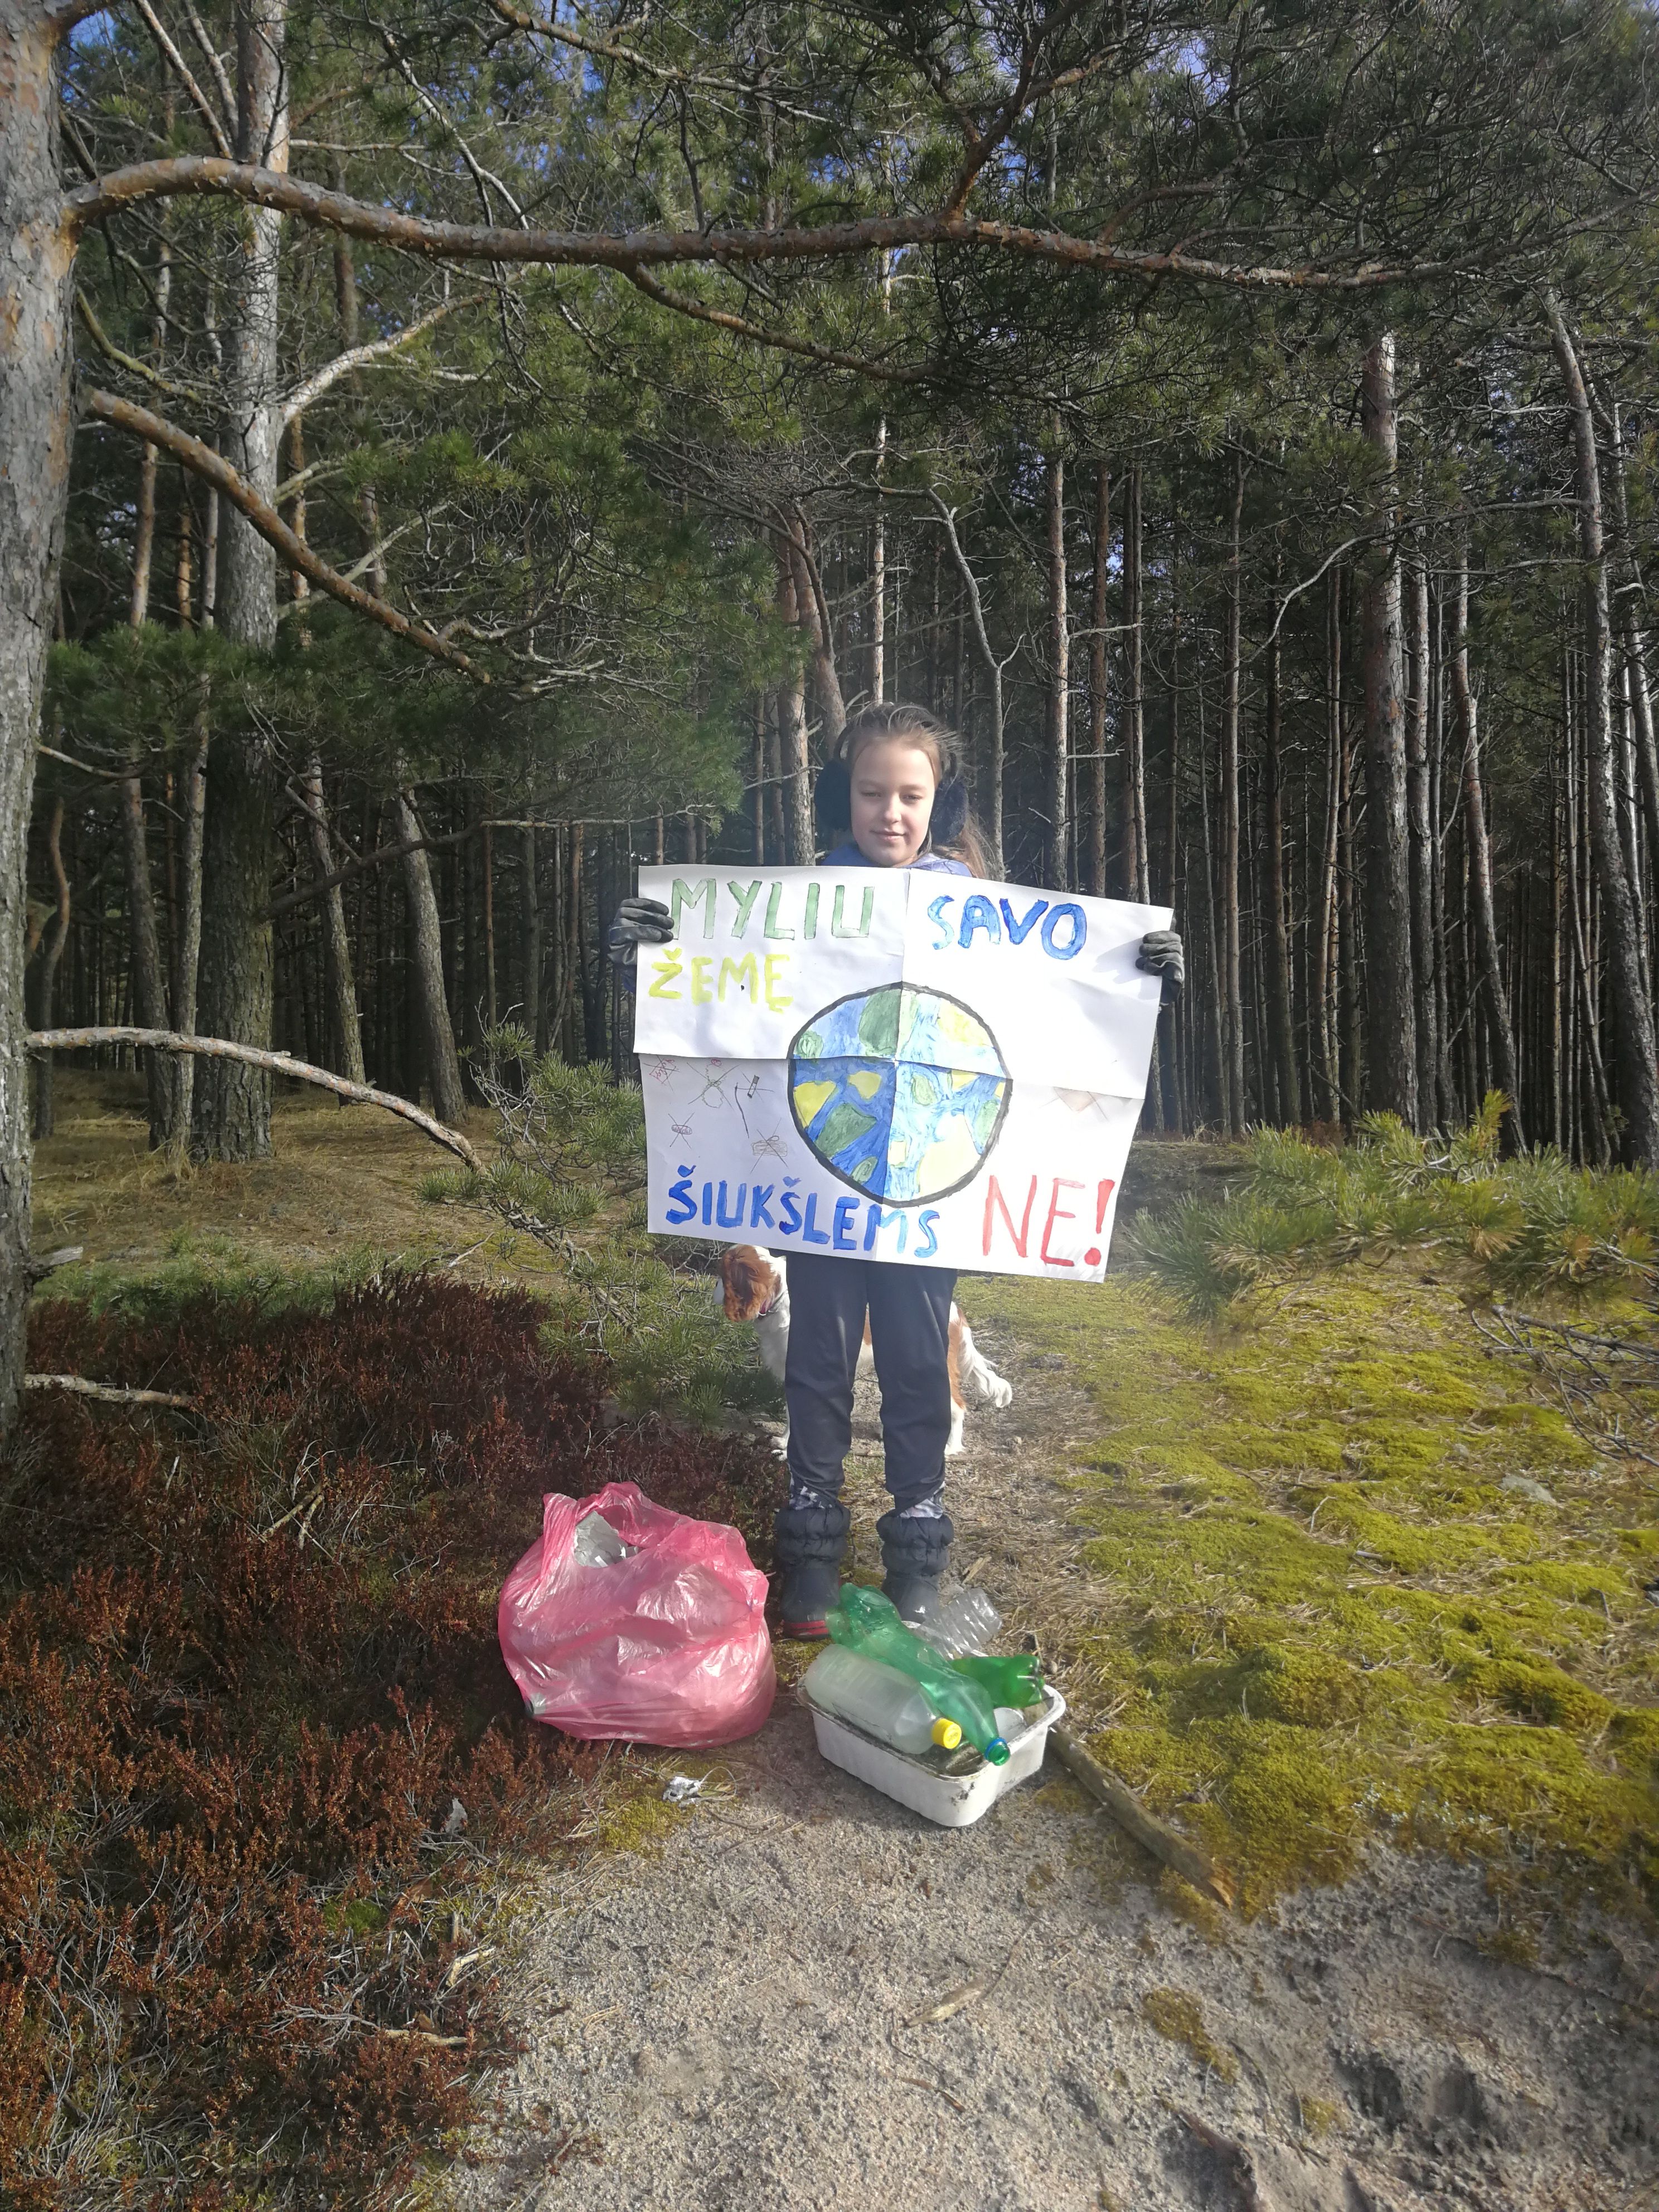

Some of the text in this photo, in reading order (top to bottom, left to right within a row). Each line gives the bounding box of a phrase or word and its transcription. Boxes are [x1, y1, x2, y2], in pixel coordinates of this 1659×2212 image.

[671, 878, 1088, 960] MYLIU SAVO
[649, 947, 794, 1013] ŽEMĘ
[666, 1165, 1115, 1267] ŠIUKŠLEMS NE!
